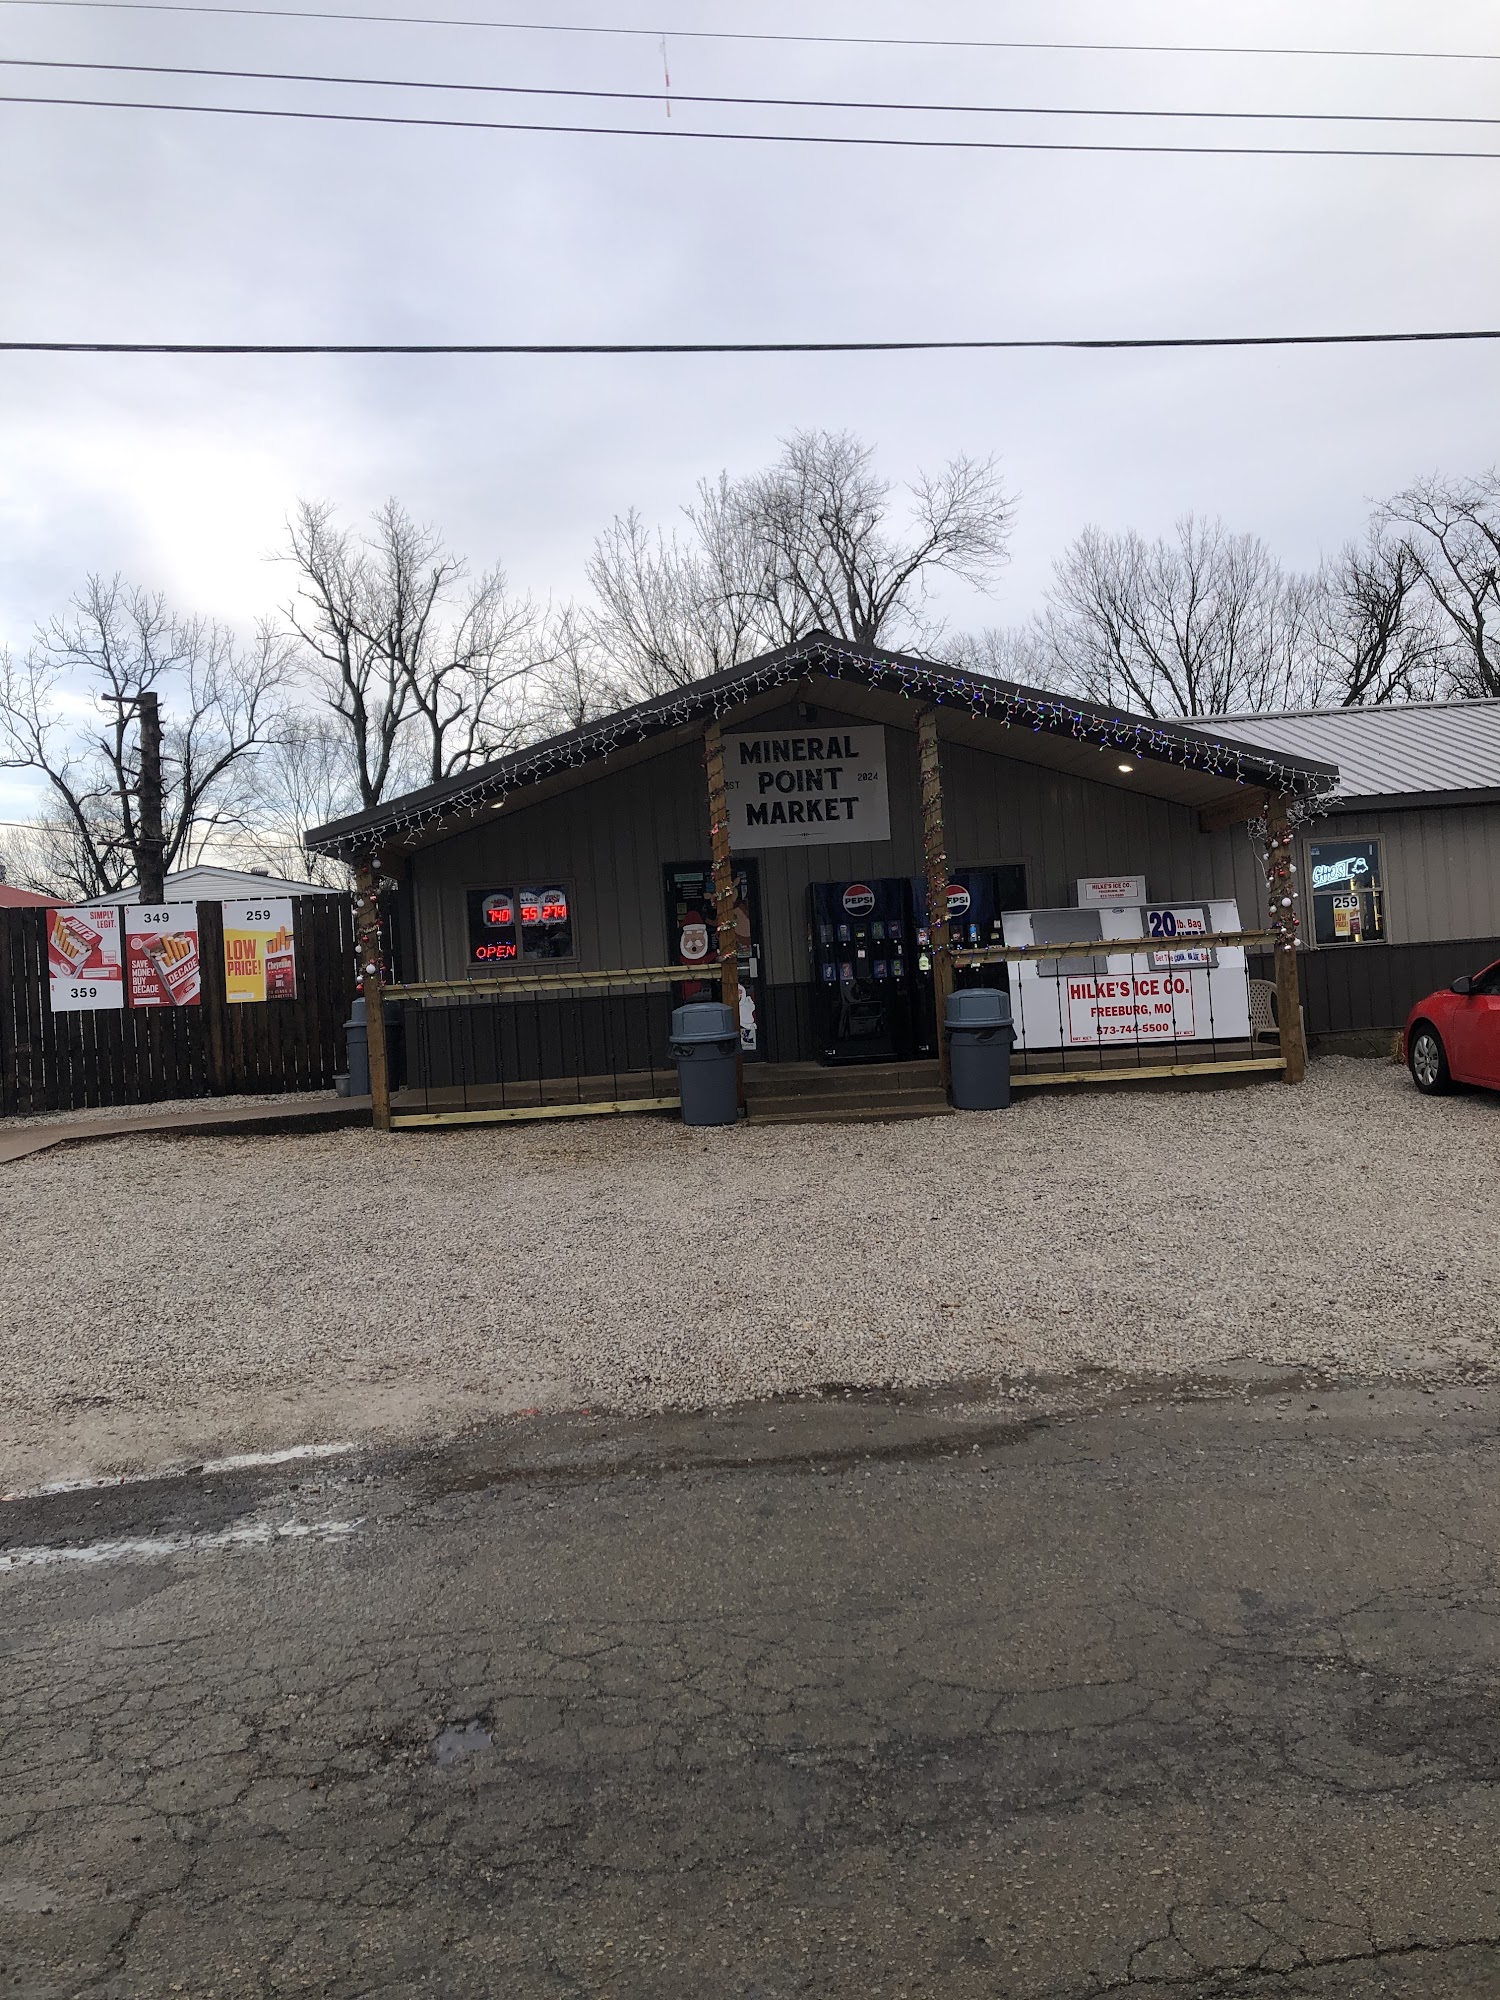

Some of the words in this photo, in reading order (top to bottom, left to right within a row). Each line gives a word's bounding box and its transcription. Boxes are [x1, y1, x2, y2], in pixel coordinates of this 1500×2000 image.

[739, 735, 860, 765] MINERAL
[758, 767, 843, 794] POINT
[857, 772, 879, 781] 2024
[746, 797, 859, 826] MARKET
[1313, 857, 1356, 887] GHOST
[844, 896, 873, 904] PEPSI
[1334, 896, 1358, 908] 259
[90, 911, 114, 920] SIMPLY
[144, 912, 169, 923] 349
[246, 910, 271, 920] 259
[489, 909, 511, 922] 740
[522, 908, 537, 920] 55
[542, 906, 565, 919] 274
[1334, 913, 1347, 922] LOW
[97, 920, 117, 928] LEGIT.
[1149, 911, 1176, 937] 20
[1187, 919, 1202, 929] Bag
[226, 939, 257, 960] LOW
[476, 945, 516, 959] OPEN
[131, 960, 149, 969] SAVE
[227, 960, 262, 976] PRICE!
[132, 968, 157, 977] MONEY.
[168, 958, 198, 984] DECADE
[132, 977, 147, 985] BUY
[70, 987, 97, 998] 359
[133, 985, 159, 994] DECADE
[1070, 981, 1130, 1000] HILKE'S
[1134, 980, 1160, 996] ICE
[1163, 978, 1189, 995] CO.
[1090, 1004, 1152, 1017] FREEBURG,
[1154, 1003, 1172, 1014] MO
[1096, 1023, 1169, 1035] 573-744-5500
